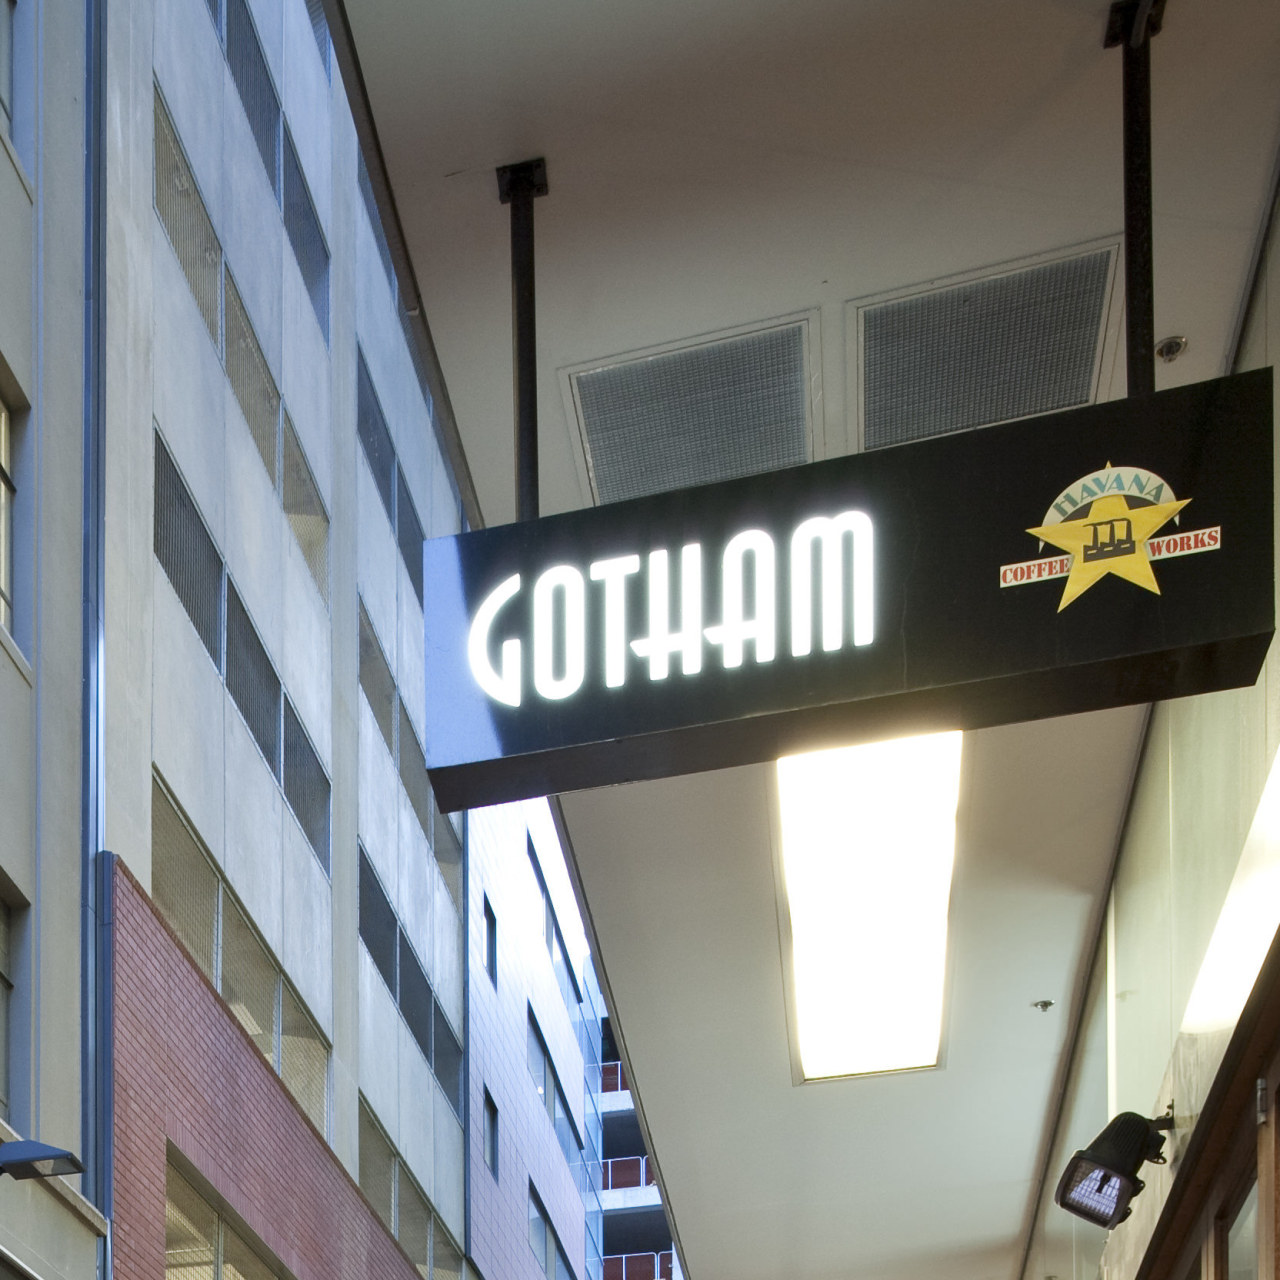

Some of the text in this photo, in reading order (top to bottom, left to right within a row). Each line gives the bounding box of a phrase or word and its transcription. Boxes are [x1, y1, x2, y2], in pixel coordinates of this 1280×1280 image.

[1052, 473, 1165, 518] HAVANA
[1001, 529, 1219, 585] COFFEE WORKS
[466, 509, 877, 708] GOTHAM
